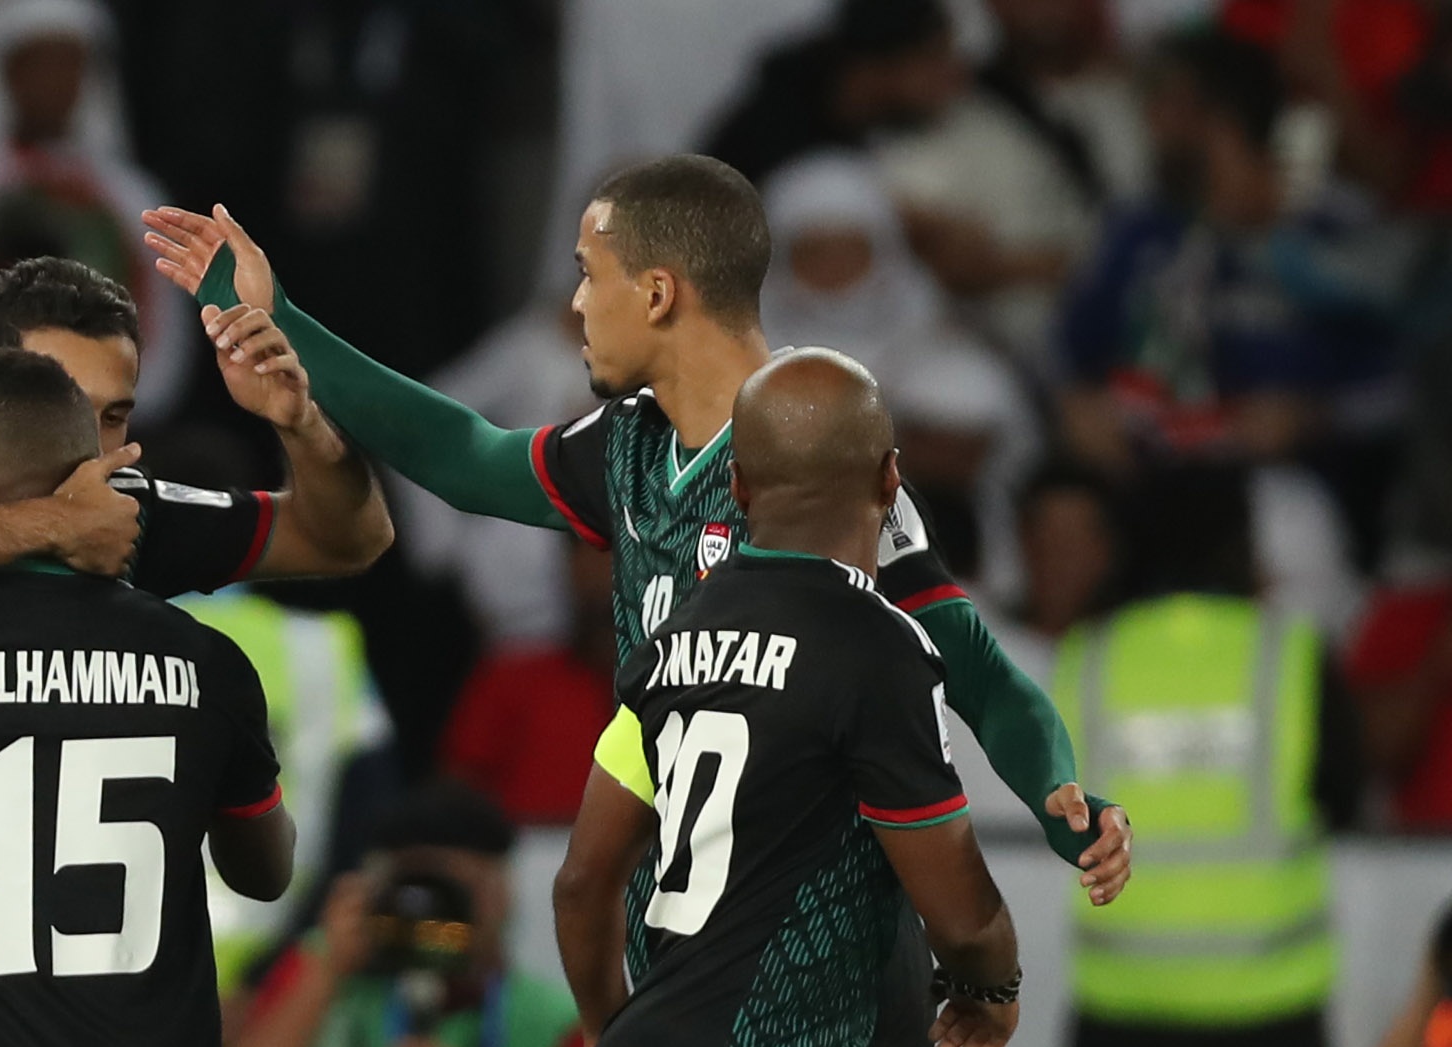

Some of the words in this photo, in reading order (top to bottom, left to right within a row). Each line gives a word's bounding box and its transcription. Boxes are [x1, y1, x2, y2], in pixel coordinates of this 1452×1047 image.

[642, 575, 674, 639] 10
[662, 630, 797, 690] MATAR
[644, 709, 750, 936] 10
